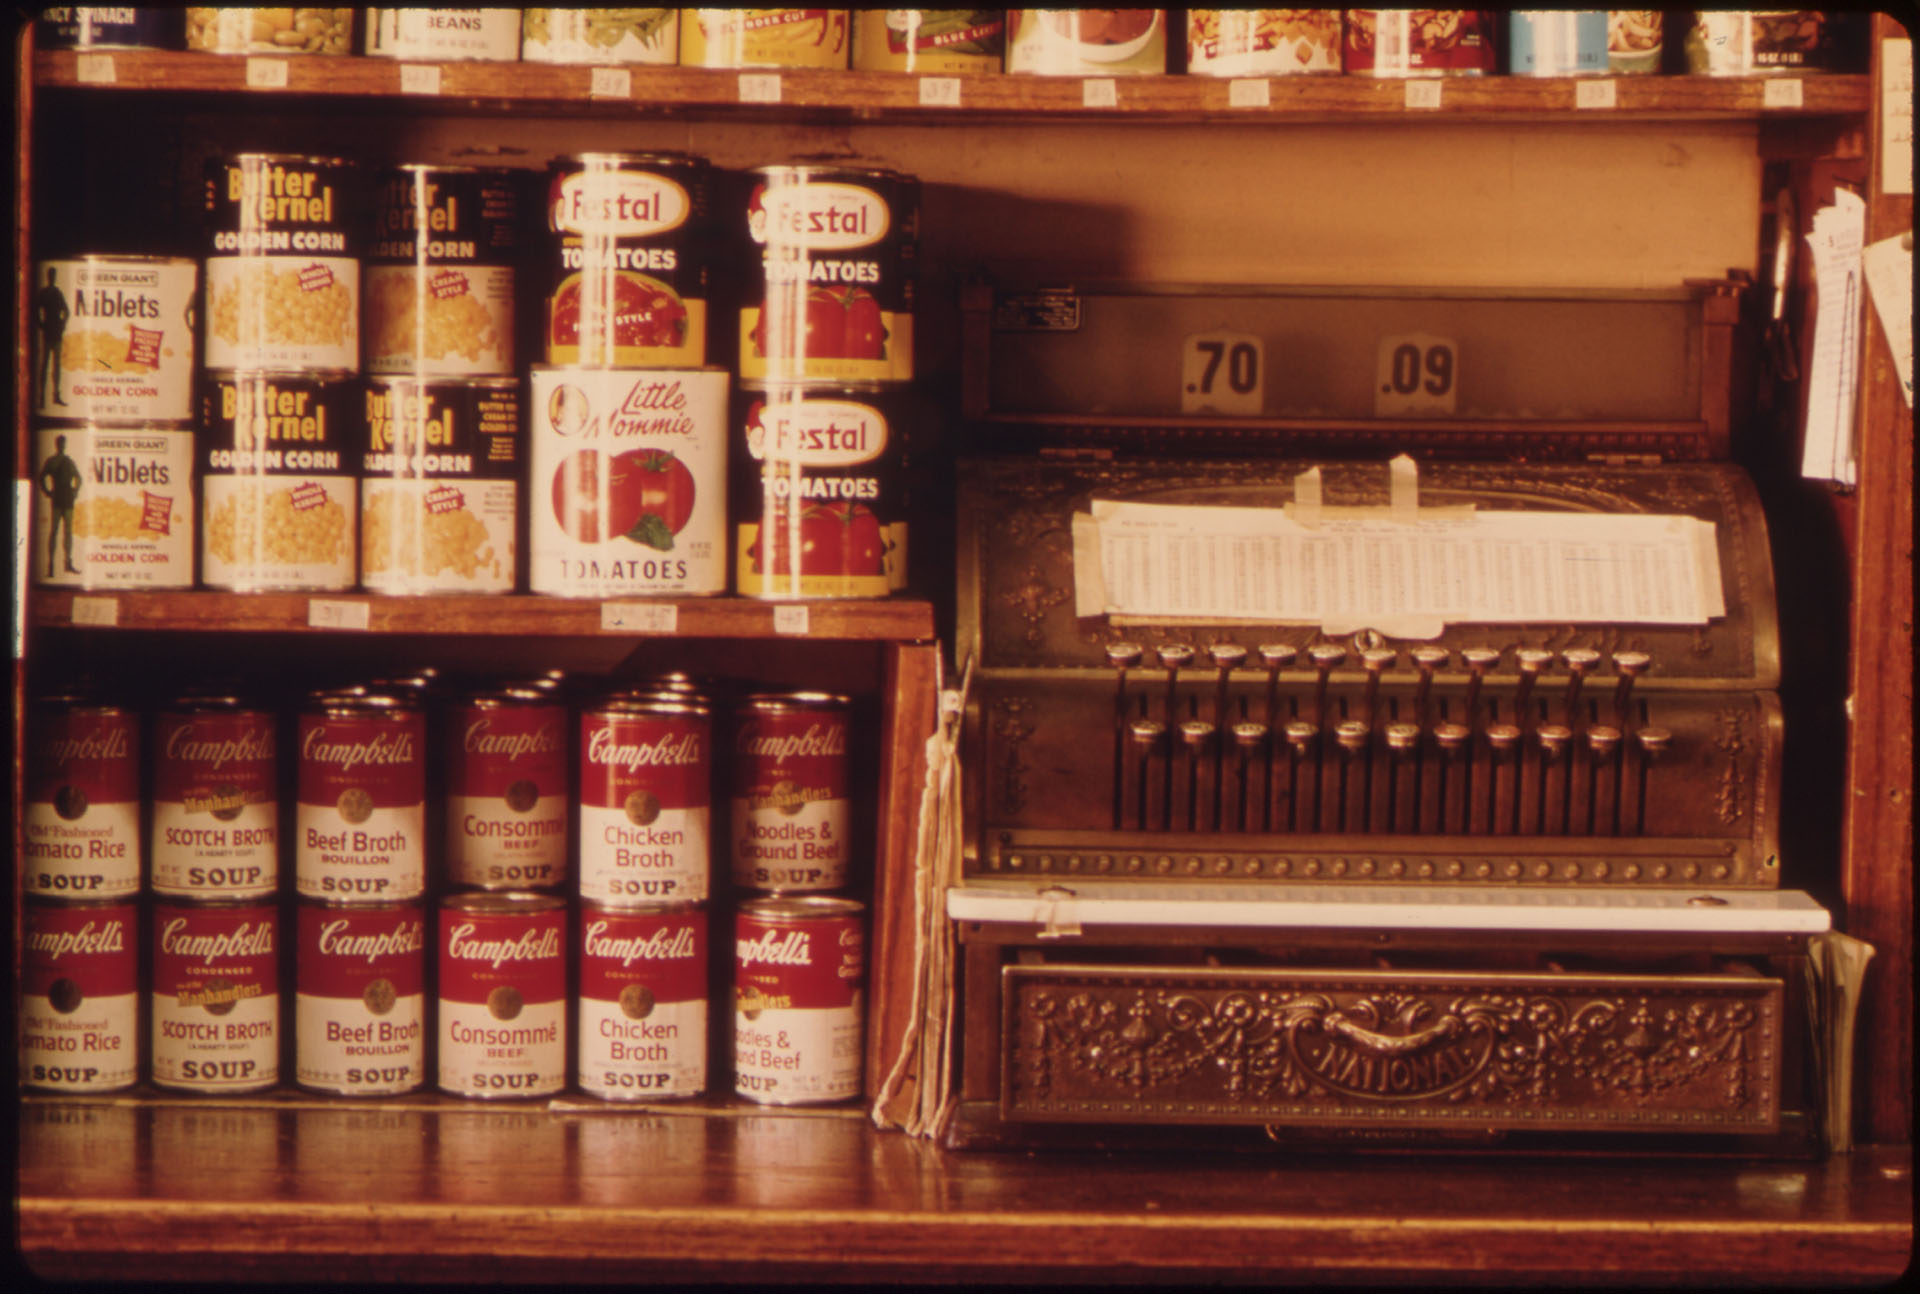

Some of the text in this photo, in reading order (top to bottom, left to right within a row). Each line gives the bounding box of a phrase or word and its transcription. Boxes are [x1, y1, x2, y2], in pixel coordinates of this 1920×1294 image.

[384, 179, 439, 208] tter
[572, 190, 661, 222] Fstal
[214, 231, 345, 251] GOLDEN CORN
[561, 247, 677, 270] TOATOES
[80, 272, 118, 282] GEEN
[75, 290, 159, 318] Niblets
[615, 311, 653, 326] STYLE
[1186, 340, 1258, 396] .70
[1381, 342, 1454, 397] .09
[72, 385, 158, 397] GOLDEN CORN
[621, 377, 688, 416] Little
[209, 450, 339, 469] GOLDN CORN
[92, 456, 169, 485] Niblets
[87, 552, 169, 564] GOLDEN CORN
[560, 559, 688, 580] TOMATOES
[165, 827, 226, 846] SCOTCH
[306, 828, 406, 852] Beef Broth
[604, 825, 684, 845] Chicken
[820, 821, 833, 840] &
[88, 839, 126, 859] Rice
[616, 848, 675, 868] Broth
[739, 838, 797, 860] Gound
[321, 854, 390, 866] BOUILLON
[38, 873, 104, 890] SOUP
[189, 866, 262, 886] SOUP
[488, 864, 553, 880] SOUP
[755, 867, 822, 884] SOUP
[322, 876, 390, 893] SOUP
[608, 879, 677, 896] SOUP
[161, 1020, 273, 1041] SCOTCH BROTH
[326, 1018, 420, 1043] Beef Broth
[450, 1020, 558, 1046] Consommé
[599, 1018, 679, 1040] Chicken
[82, 1032, 121, 1052] Rice
[345, 1043, 411, 1056] BOUILLON
[776, 1030, 791, 1049] &
[610, 1041, 669, 1062] Broth
[760, 1049, 802, 1071] Beef
[32, 1064, 99, 1083] SOUP
[182, 1060, 256, 1079] SOUP
[346, 1066, 411, 1084] SOUP
[472, 1072, 540, 1089] SOUP
[603, 1071, 671, 1089] SOUP
